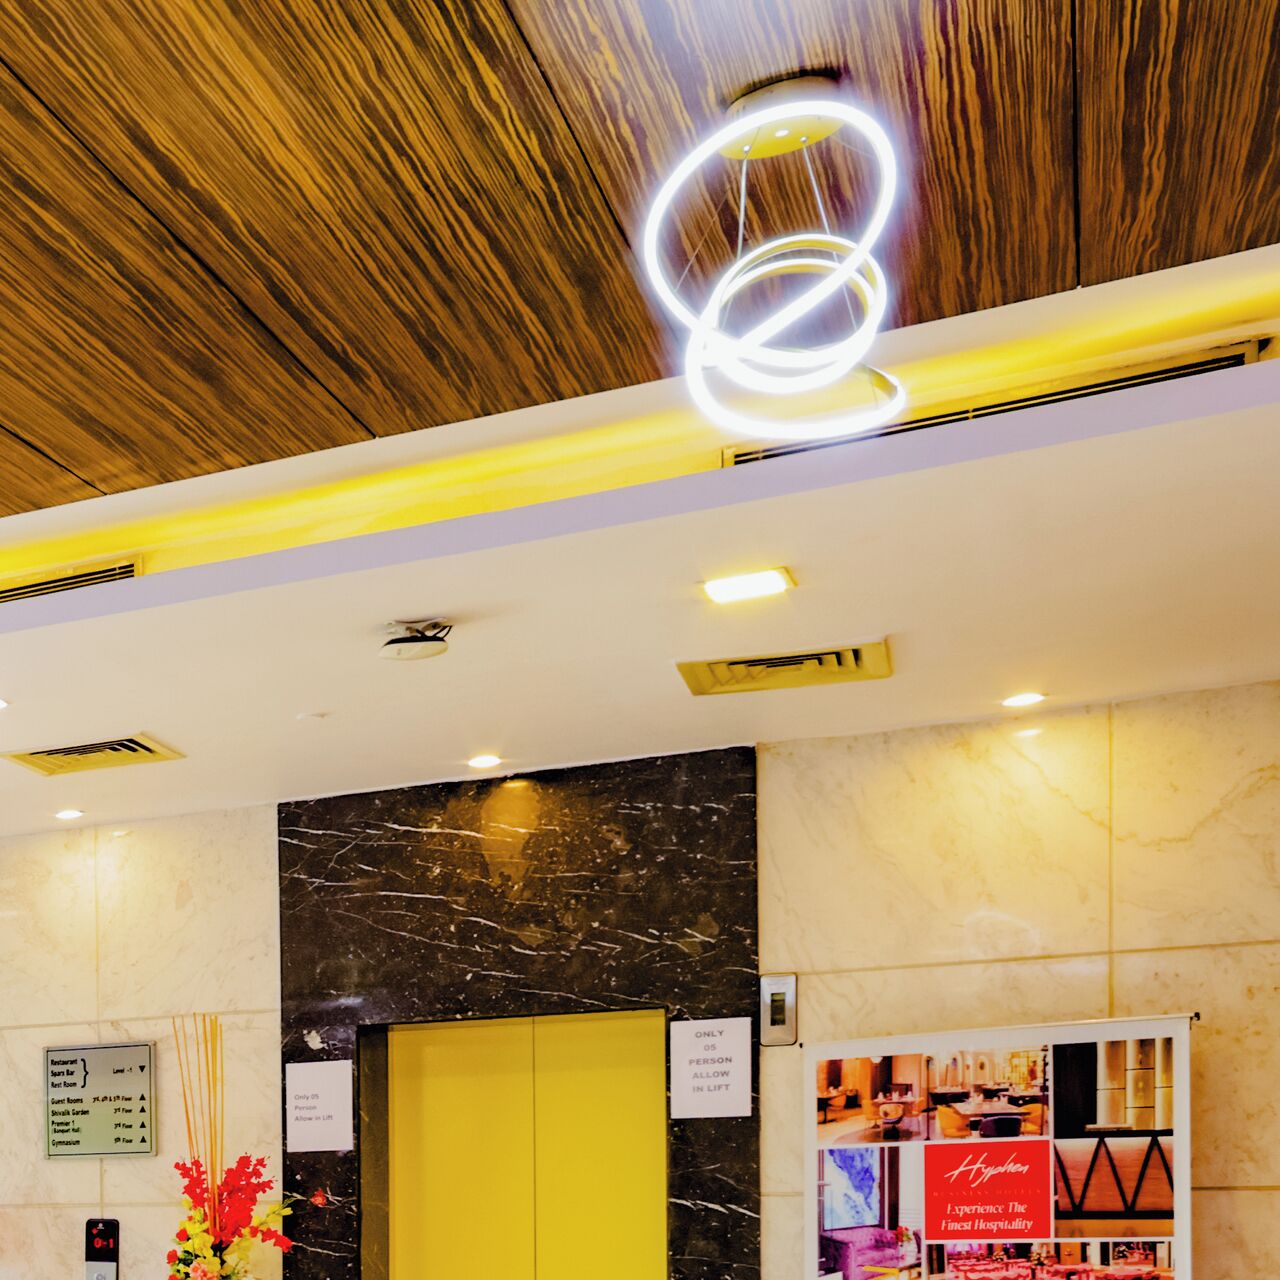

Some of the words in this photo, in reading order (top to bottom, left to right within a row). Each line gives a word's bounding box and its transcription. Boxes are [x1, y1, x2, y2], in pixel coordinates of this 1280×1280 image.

[695, 1030, 724, 1039] ONLY
[703, 1044, 717, 1052] 05
[688, 1056, 733, 1066] PERSON
[692, 1070, 730, 1079] ALLOW
[707, 1084, 730, 1092] LIFT
[944, 1152, 1030, 1187] Hyphen
[947, 1202, 1004, 1218] Experience
[1008, 1201, 1028, 1213] The
[942, 1219, 972, 1231] Finest
[974, 1218, 1033, 1233] Hospitality
